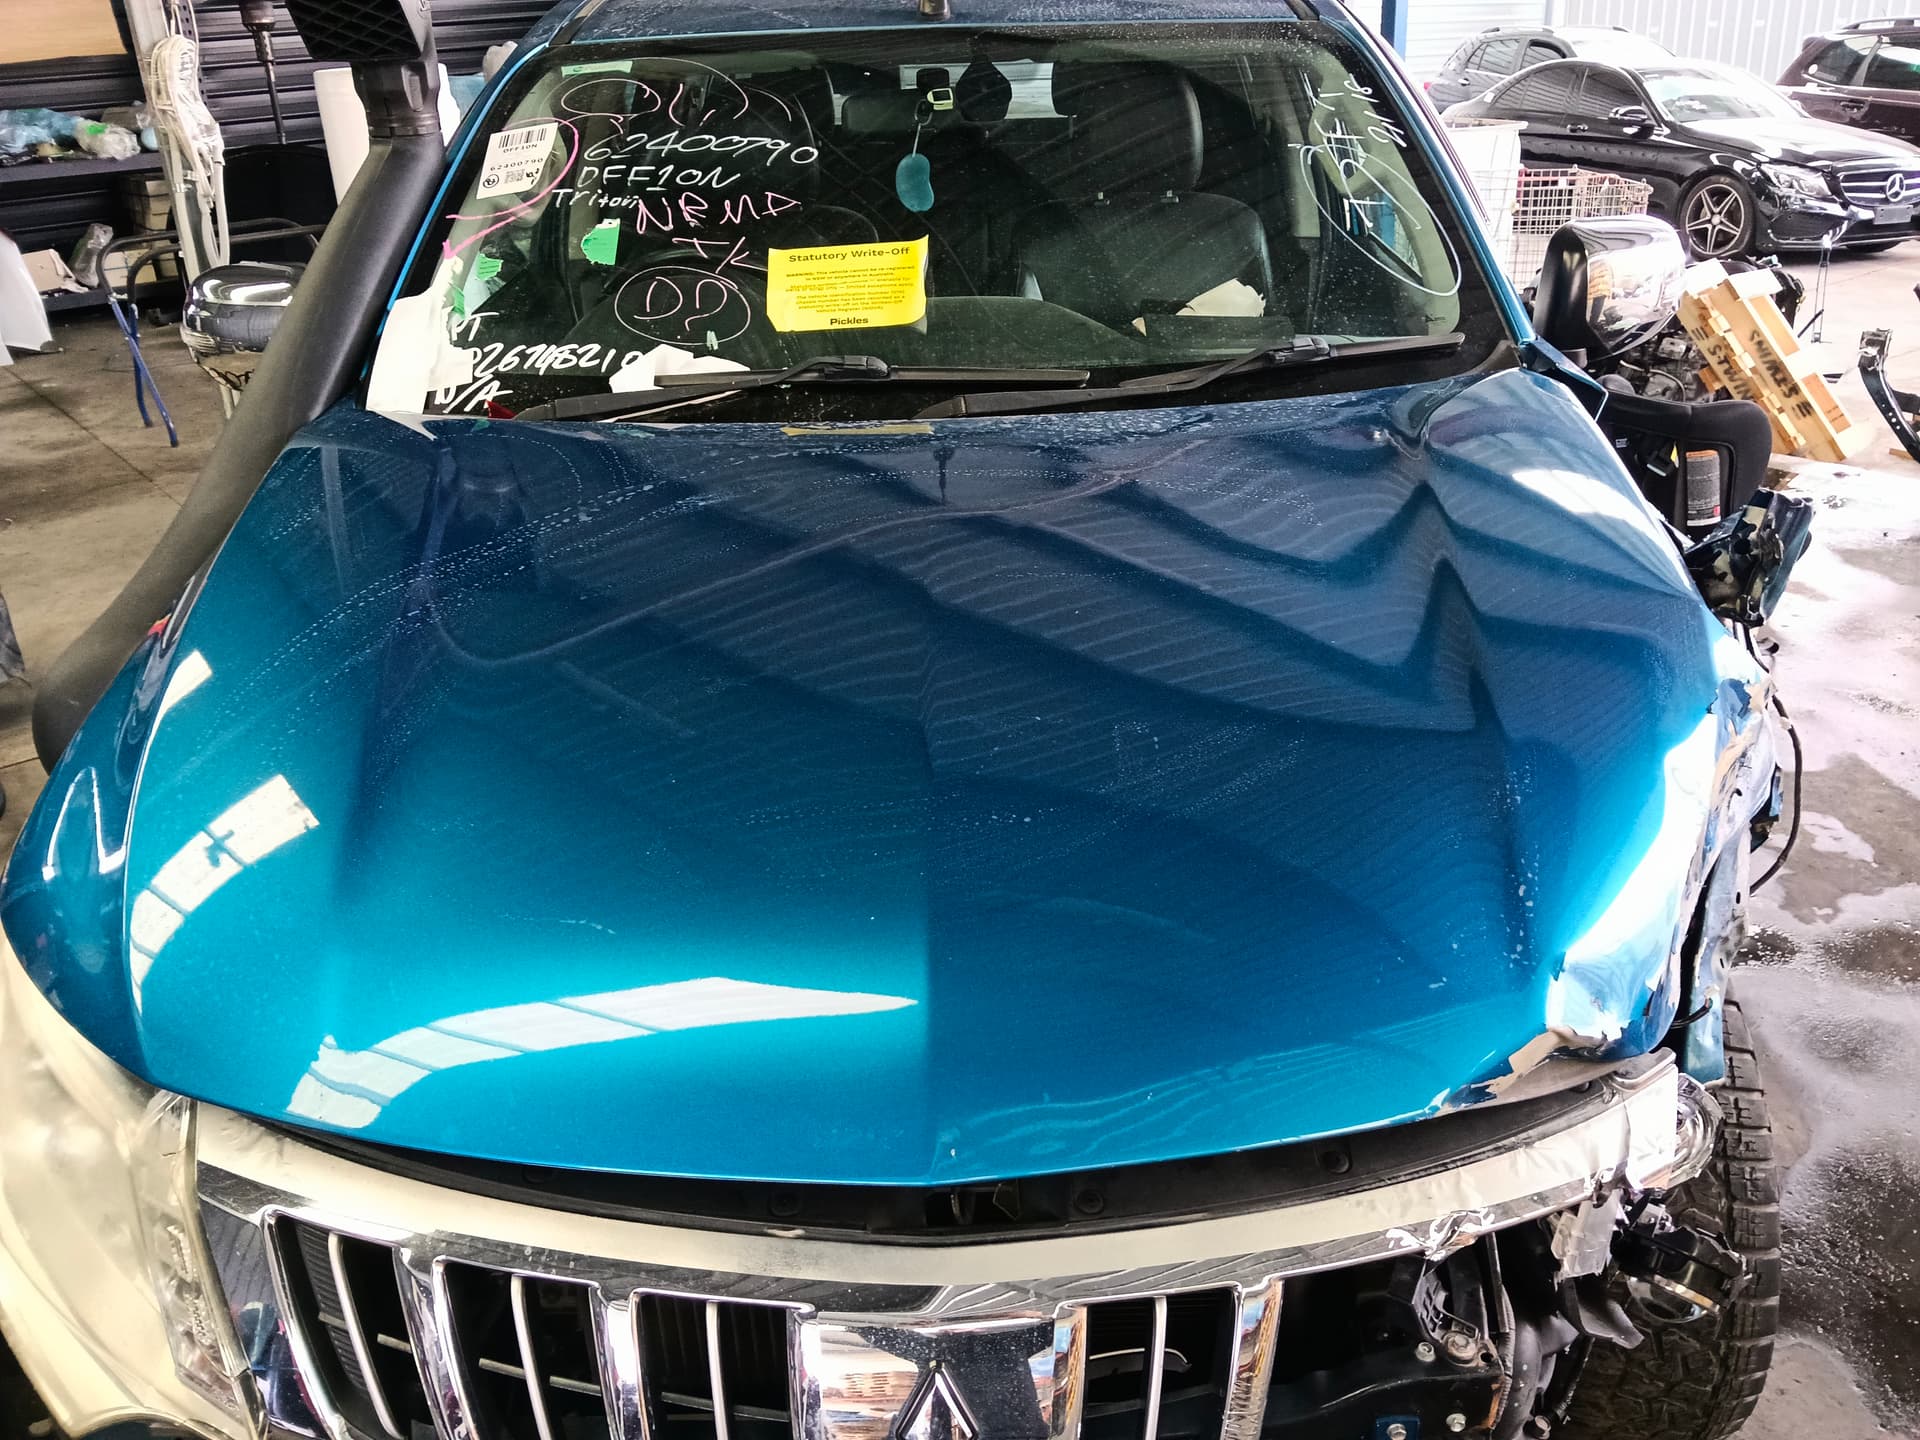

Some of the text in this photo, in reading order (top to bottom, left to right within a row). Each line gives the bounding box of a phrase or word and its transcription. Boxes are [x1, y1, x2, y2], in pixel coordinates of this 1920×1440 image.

[583, 130, 819, 167] 62400790
[788, 246, 911, 263] Statutory Write-Off
[829, 316, 869, 325] Pickles
